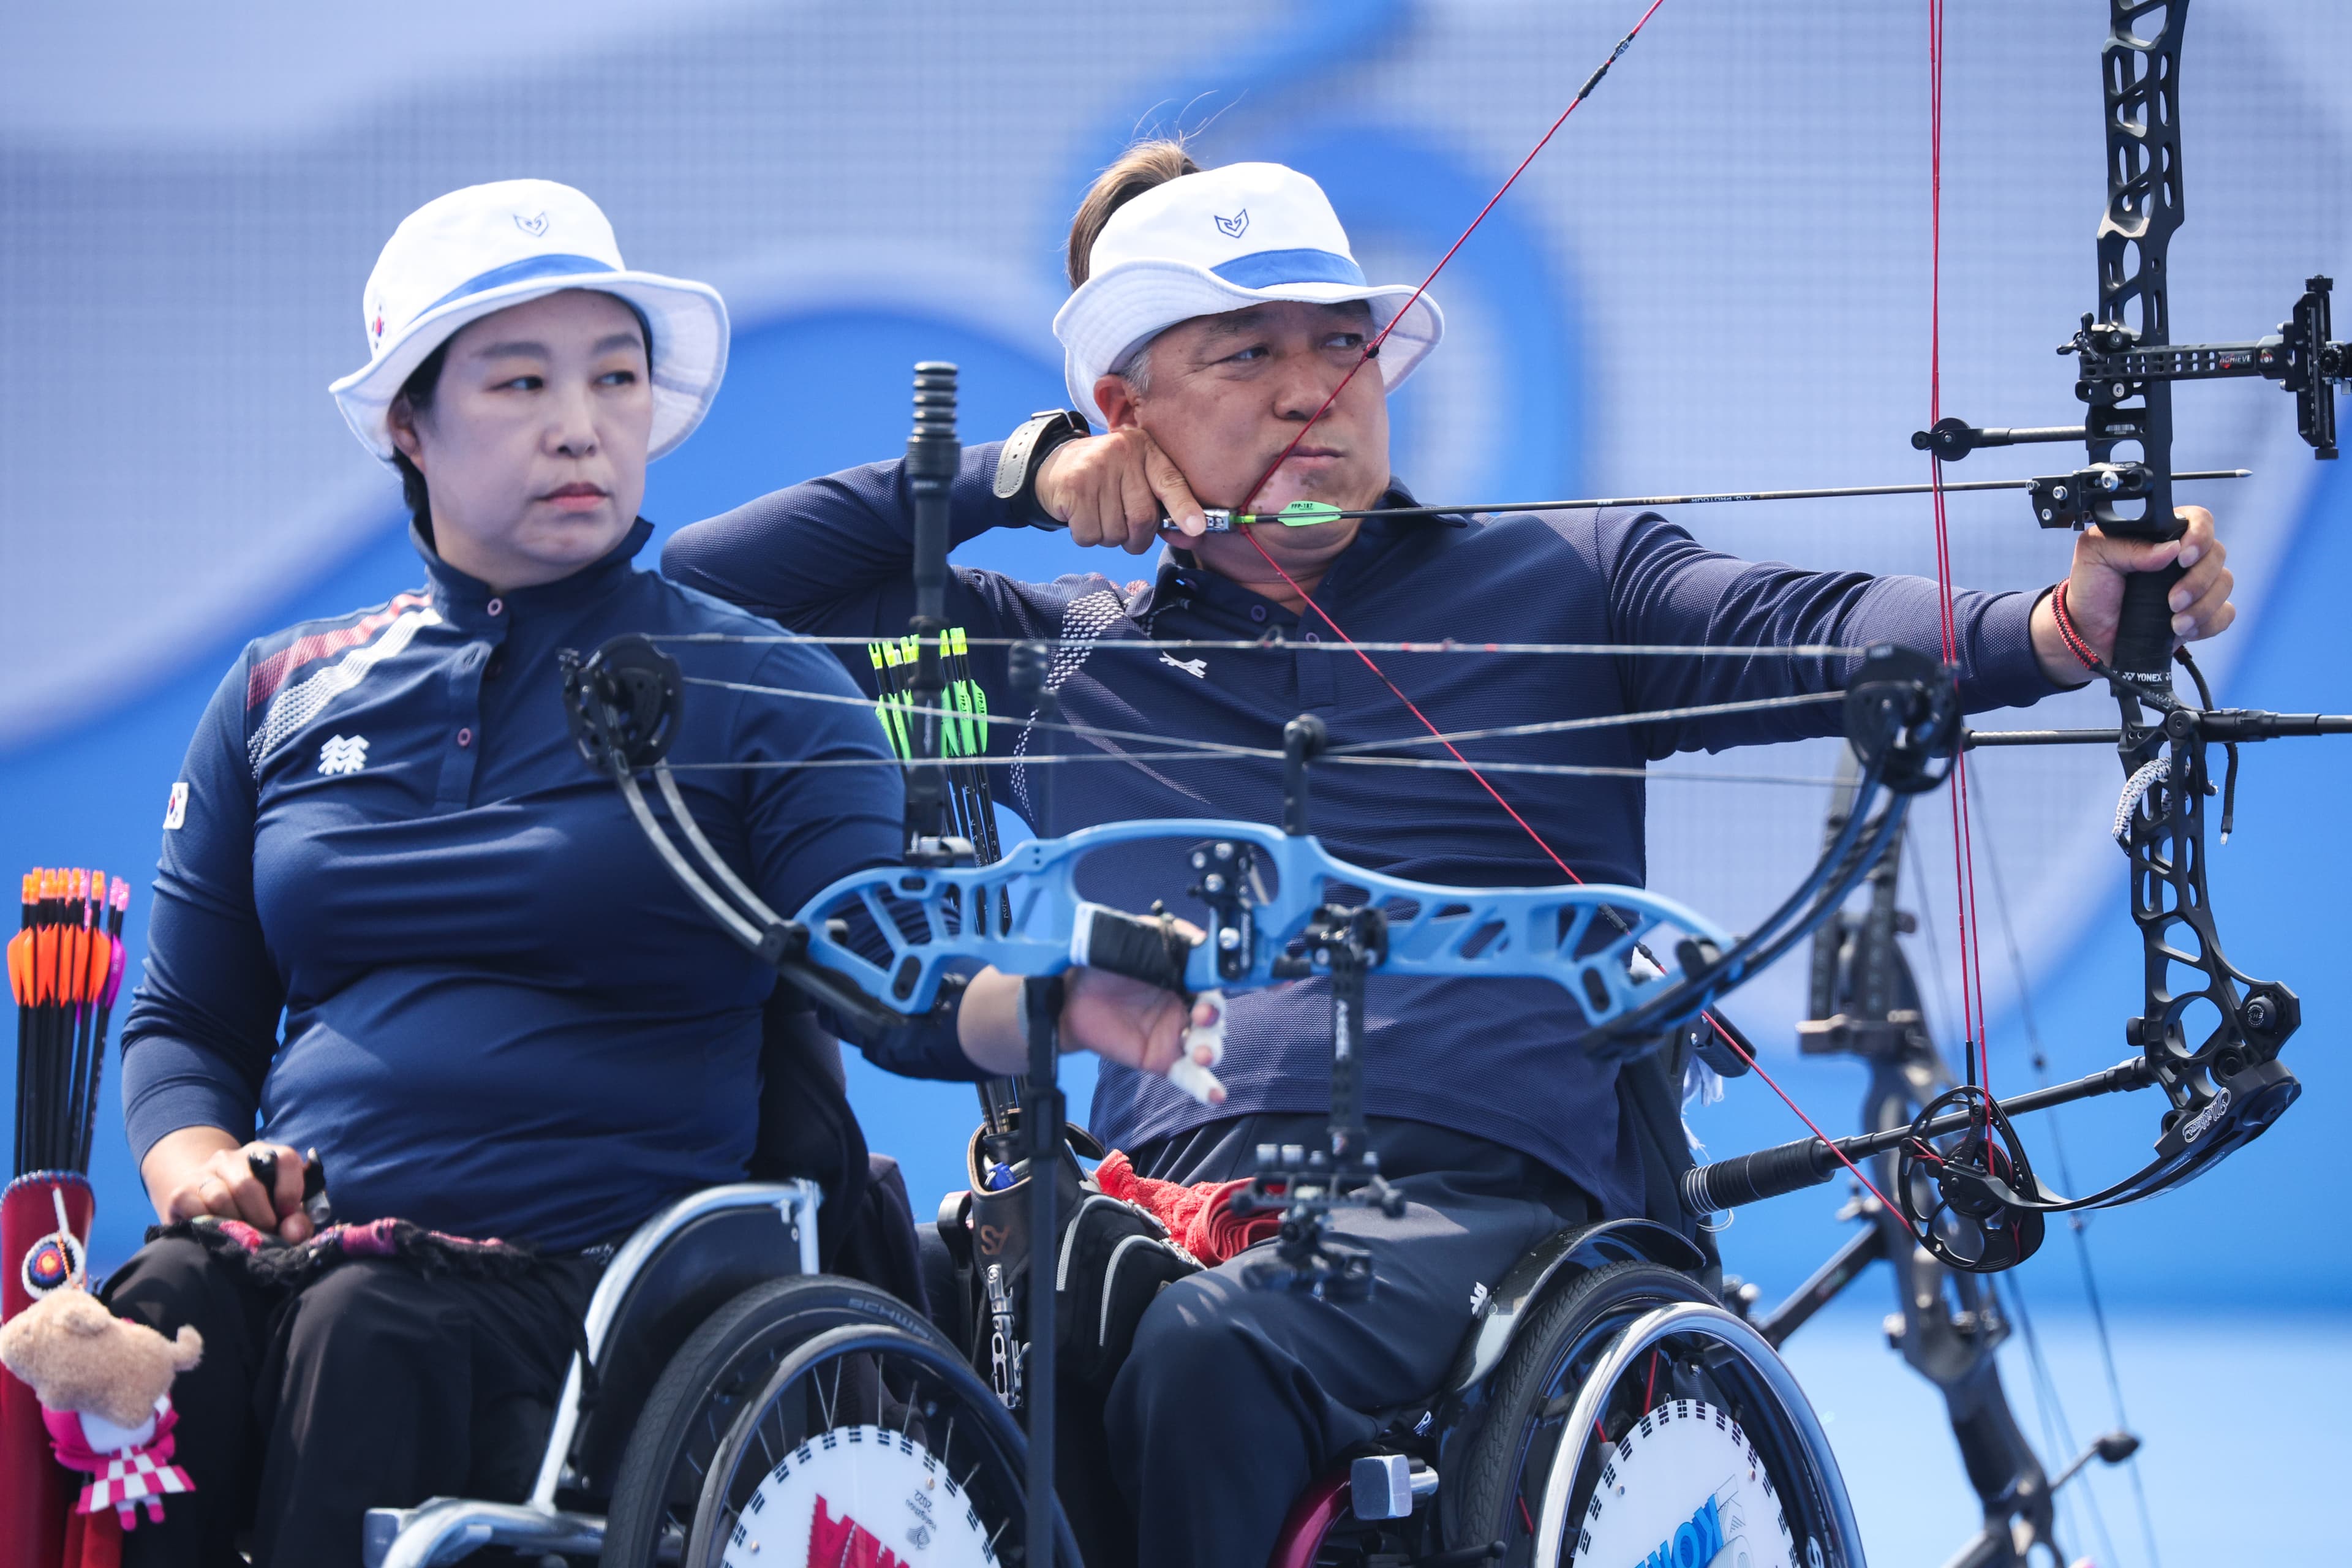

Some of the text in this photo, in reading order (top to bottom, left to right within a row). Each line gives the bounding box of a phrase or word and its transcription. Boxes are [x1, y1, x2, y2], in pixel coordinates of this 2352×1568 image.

[2219, 354, 2252, 364] ACHIEVE
[2136, 672, 2163, 682] YONEX
[914, 1489, 932, 1513] 2022
